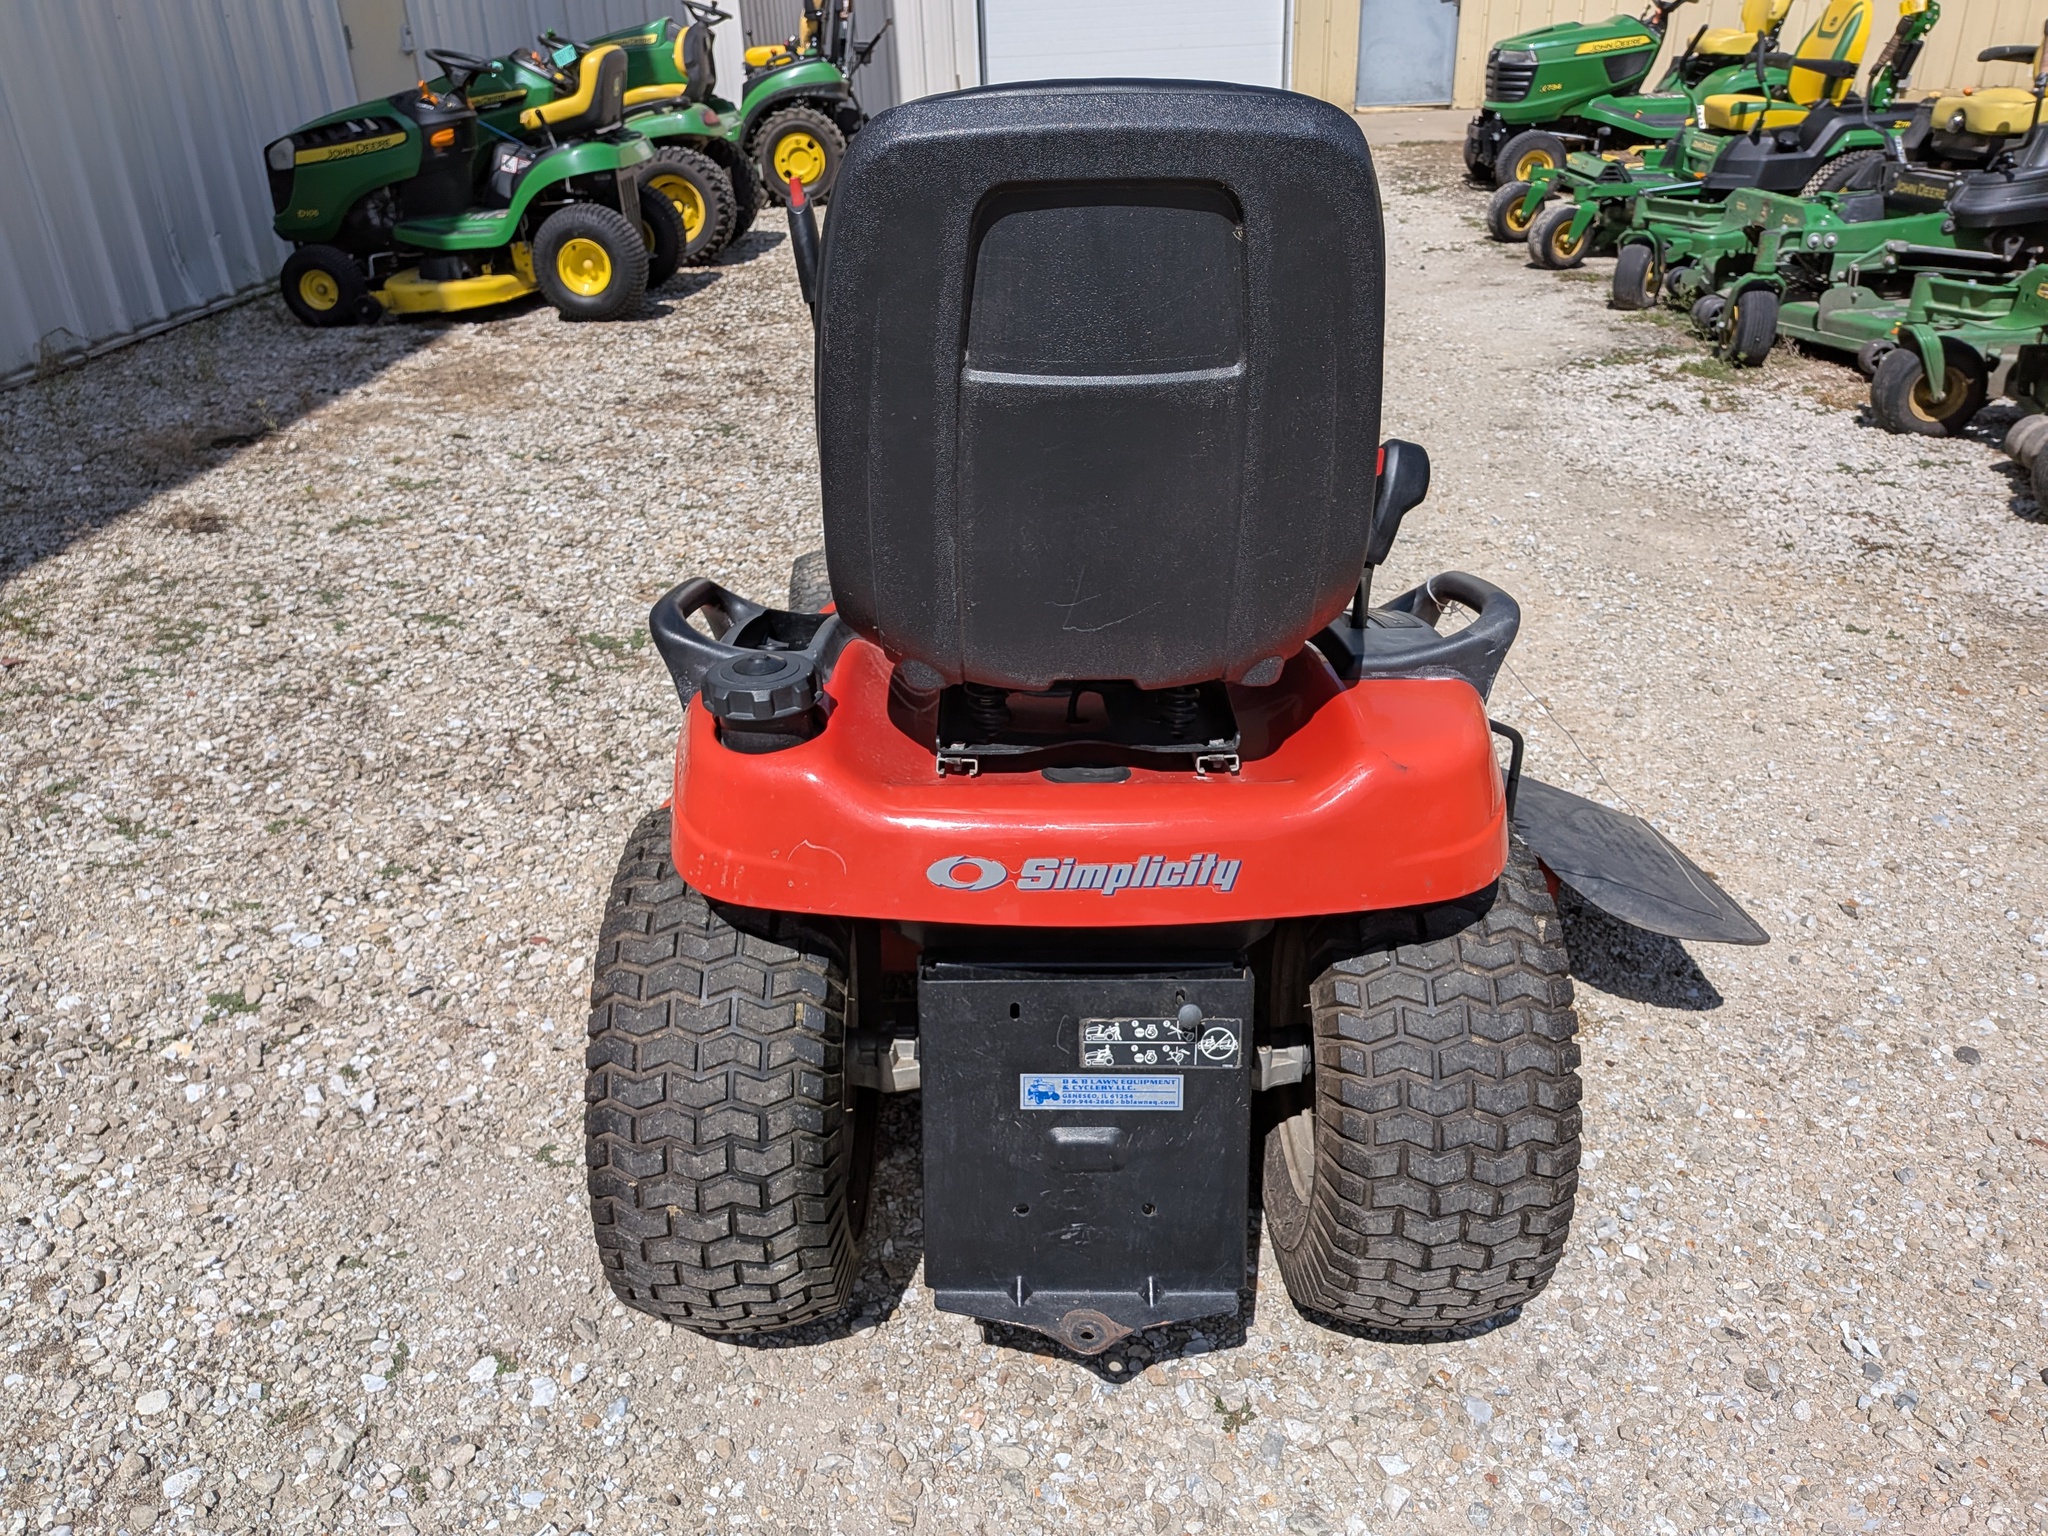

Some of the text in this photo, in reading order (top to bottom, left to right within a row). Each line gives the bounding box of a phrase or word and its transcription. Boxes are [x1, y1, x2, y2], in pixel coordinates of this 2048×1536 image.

[1591, 37, 1642, 53] JOHN DEERE
[328, 138, 391, 160] JOHN DEERE
[1894, 180, 1948, 200] JOHN DEERE
[1016, 852, 1244, 896] Simplicity
